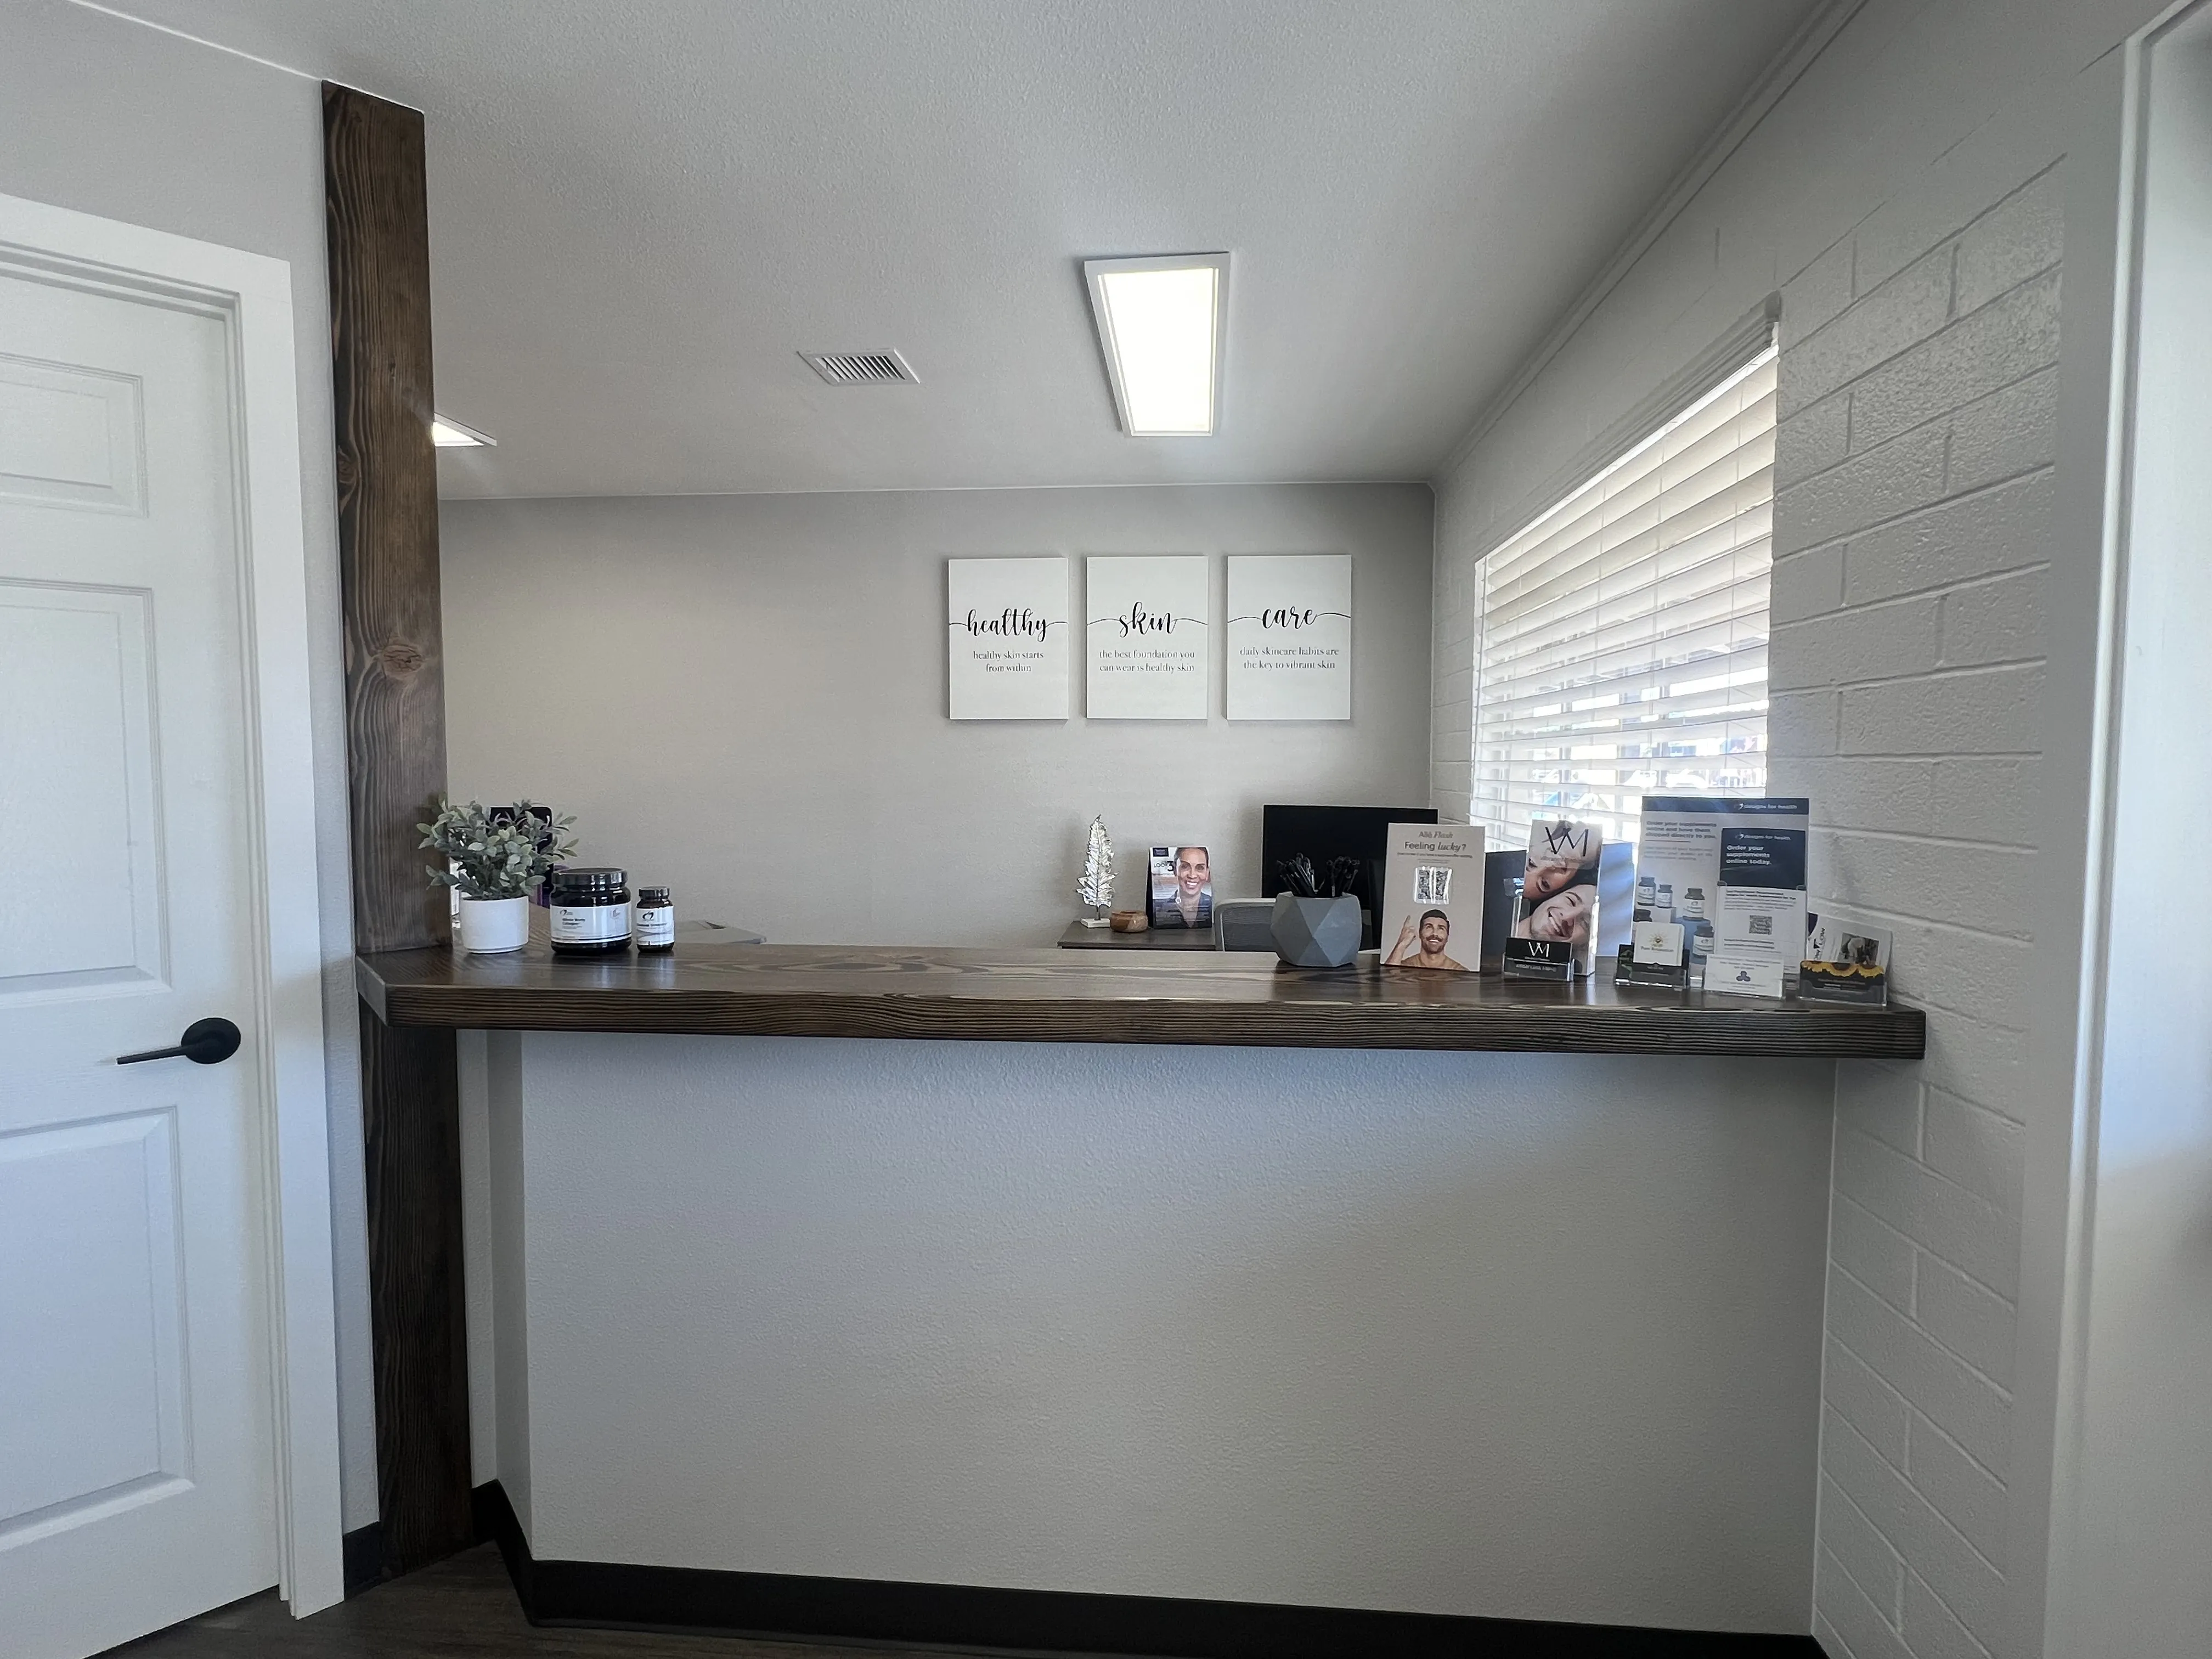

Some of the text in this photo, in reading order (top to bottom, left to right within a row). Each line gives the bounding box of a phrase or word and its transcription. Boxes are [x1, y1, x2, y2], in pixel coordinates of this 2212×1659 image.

[1119, 601, 1177, 638] skin
[1262, 606, 1317, 629] care
[967, 608, 1046, 642] healthy
[973, 651, 1001, 661] healthy
[1003, 651, 1020, 659] skin
[1099, 650, 1195, 661] the best foundation you
[1239, 646, 1260, 658] daily
[1261, 646, 1297, 656] skincare
[1298, 646, 1324, 656] habits
[986, 663, 1032, 672] from within
[1137, 663, 1144, 672] is
[1146, 662, 1175, 674] healthy
[1177, 663, 1195, 672] skin
[1243, 660, 1336, 672] the key to vibrant skin
[1404, 841, 1435, 851] Feeling
